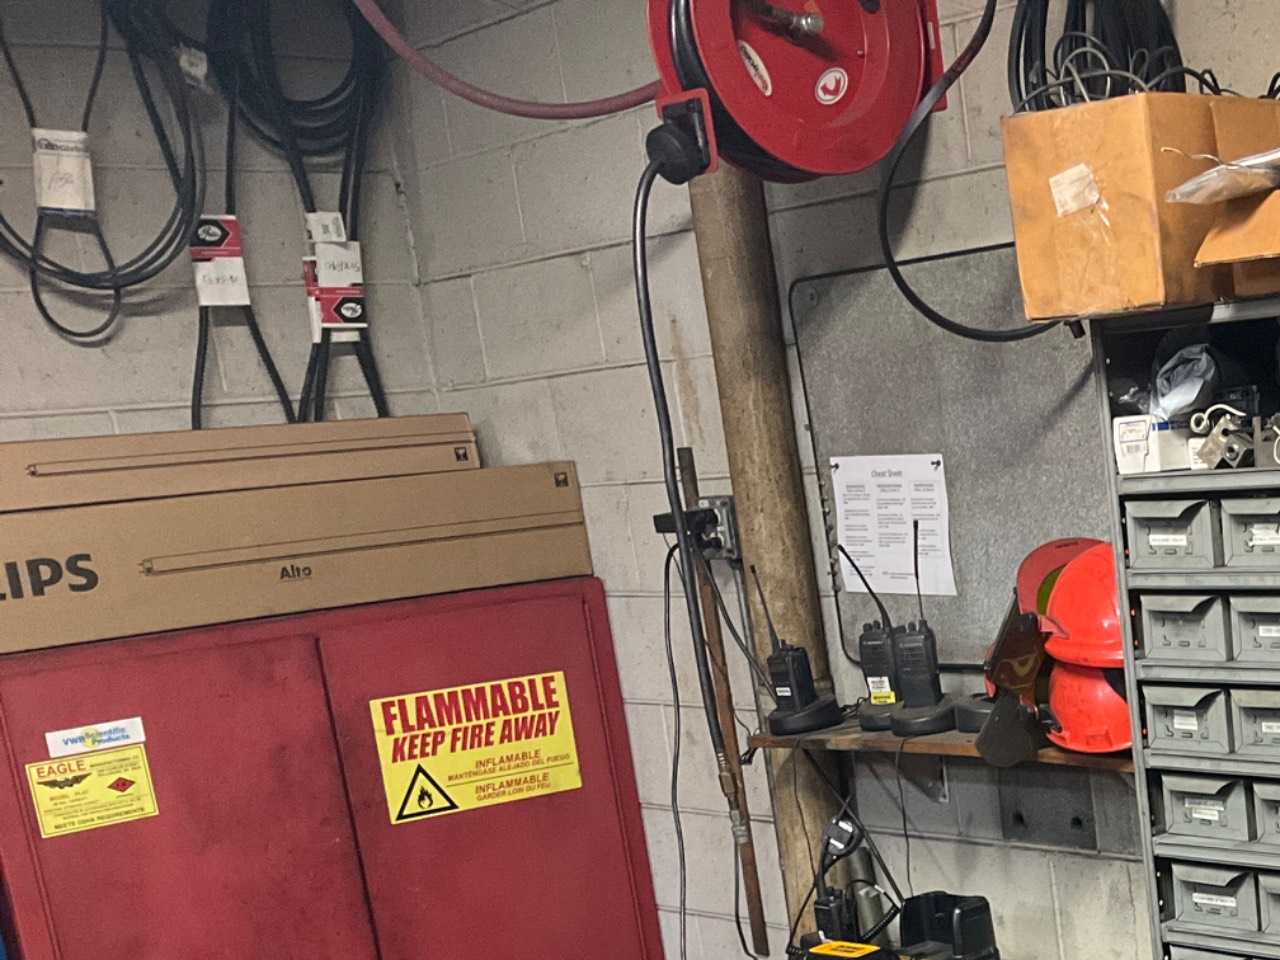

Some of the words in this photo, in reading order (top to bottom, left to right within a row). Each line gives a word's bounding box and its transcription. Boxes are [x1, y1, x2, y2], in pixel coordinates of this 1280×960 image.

[0, 553, 99, 600] IPS
[381, 676, 560, 736] FLAMMABLE
[392, 730, 446, 763] KEEP
[450, 722, 496, 753] FIRE
[499, 711, 560, 745] AWAY
[36, 760, 87, 778] EAGLE
[475, 749, 541, 769] INFLAMABLE
[475, 772, 549, 793] INFLAMMABLE
